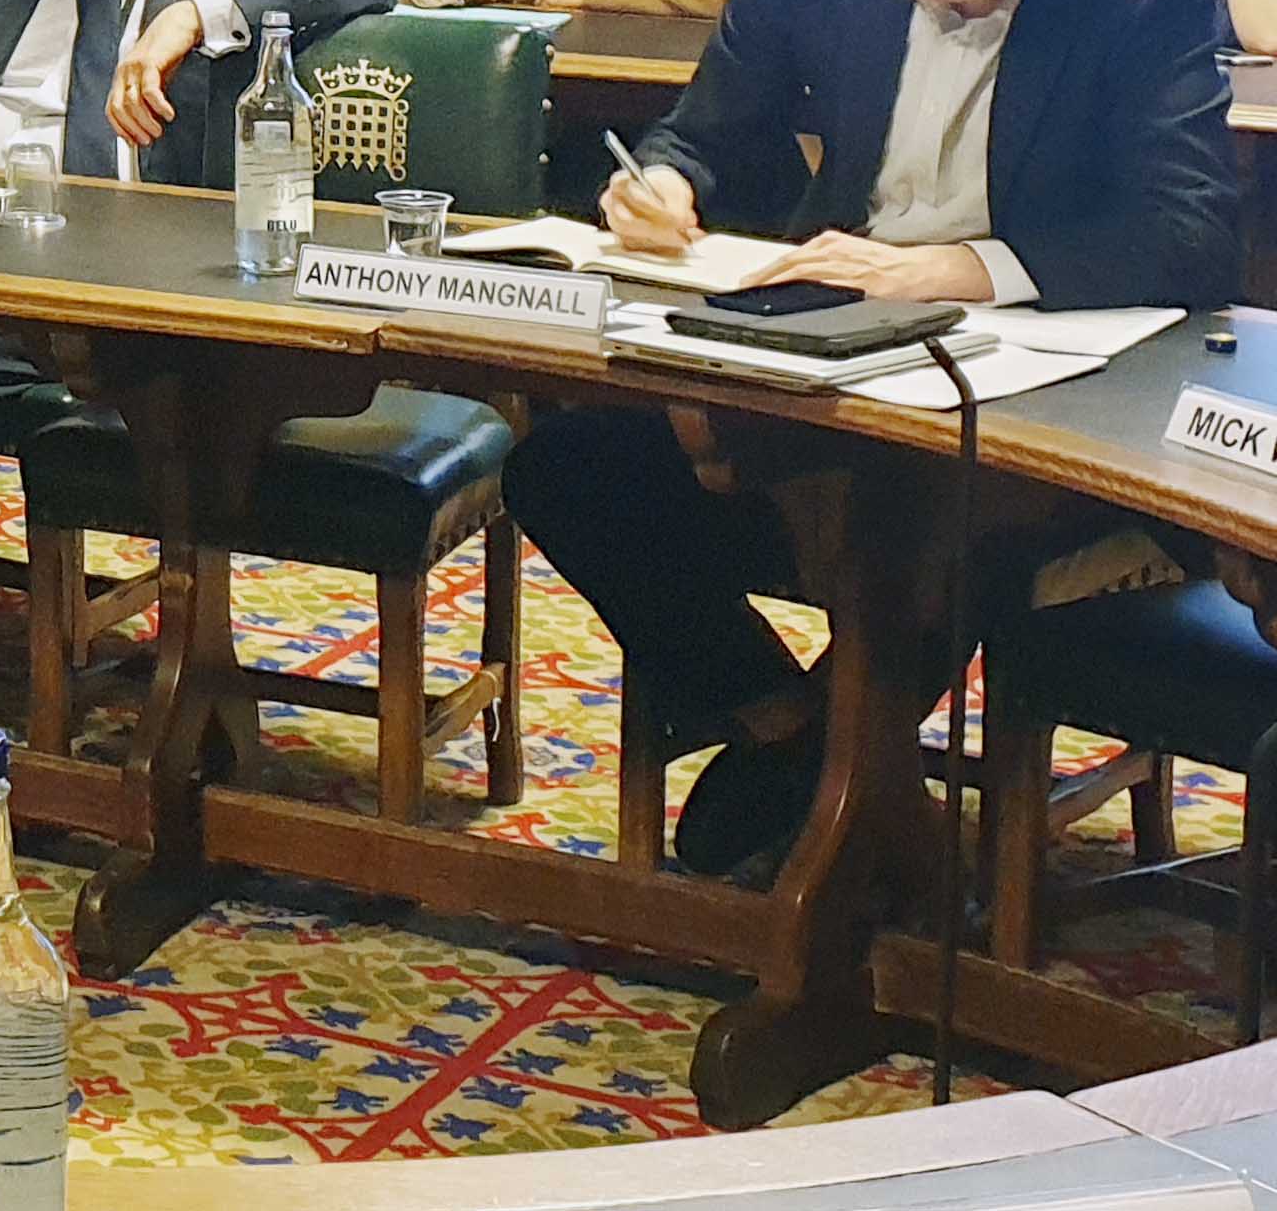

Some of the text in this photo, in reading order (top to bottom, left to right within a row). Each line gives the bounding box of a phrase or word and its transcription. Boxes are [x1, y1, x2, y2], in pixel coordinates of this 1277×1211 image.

[305, 262, 587, 316] ANTHONY MANGNALL
[1187, 407, 1268, 457] MICK
